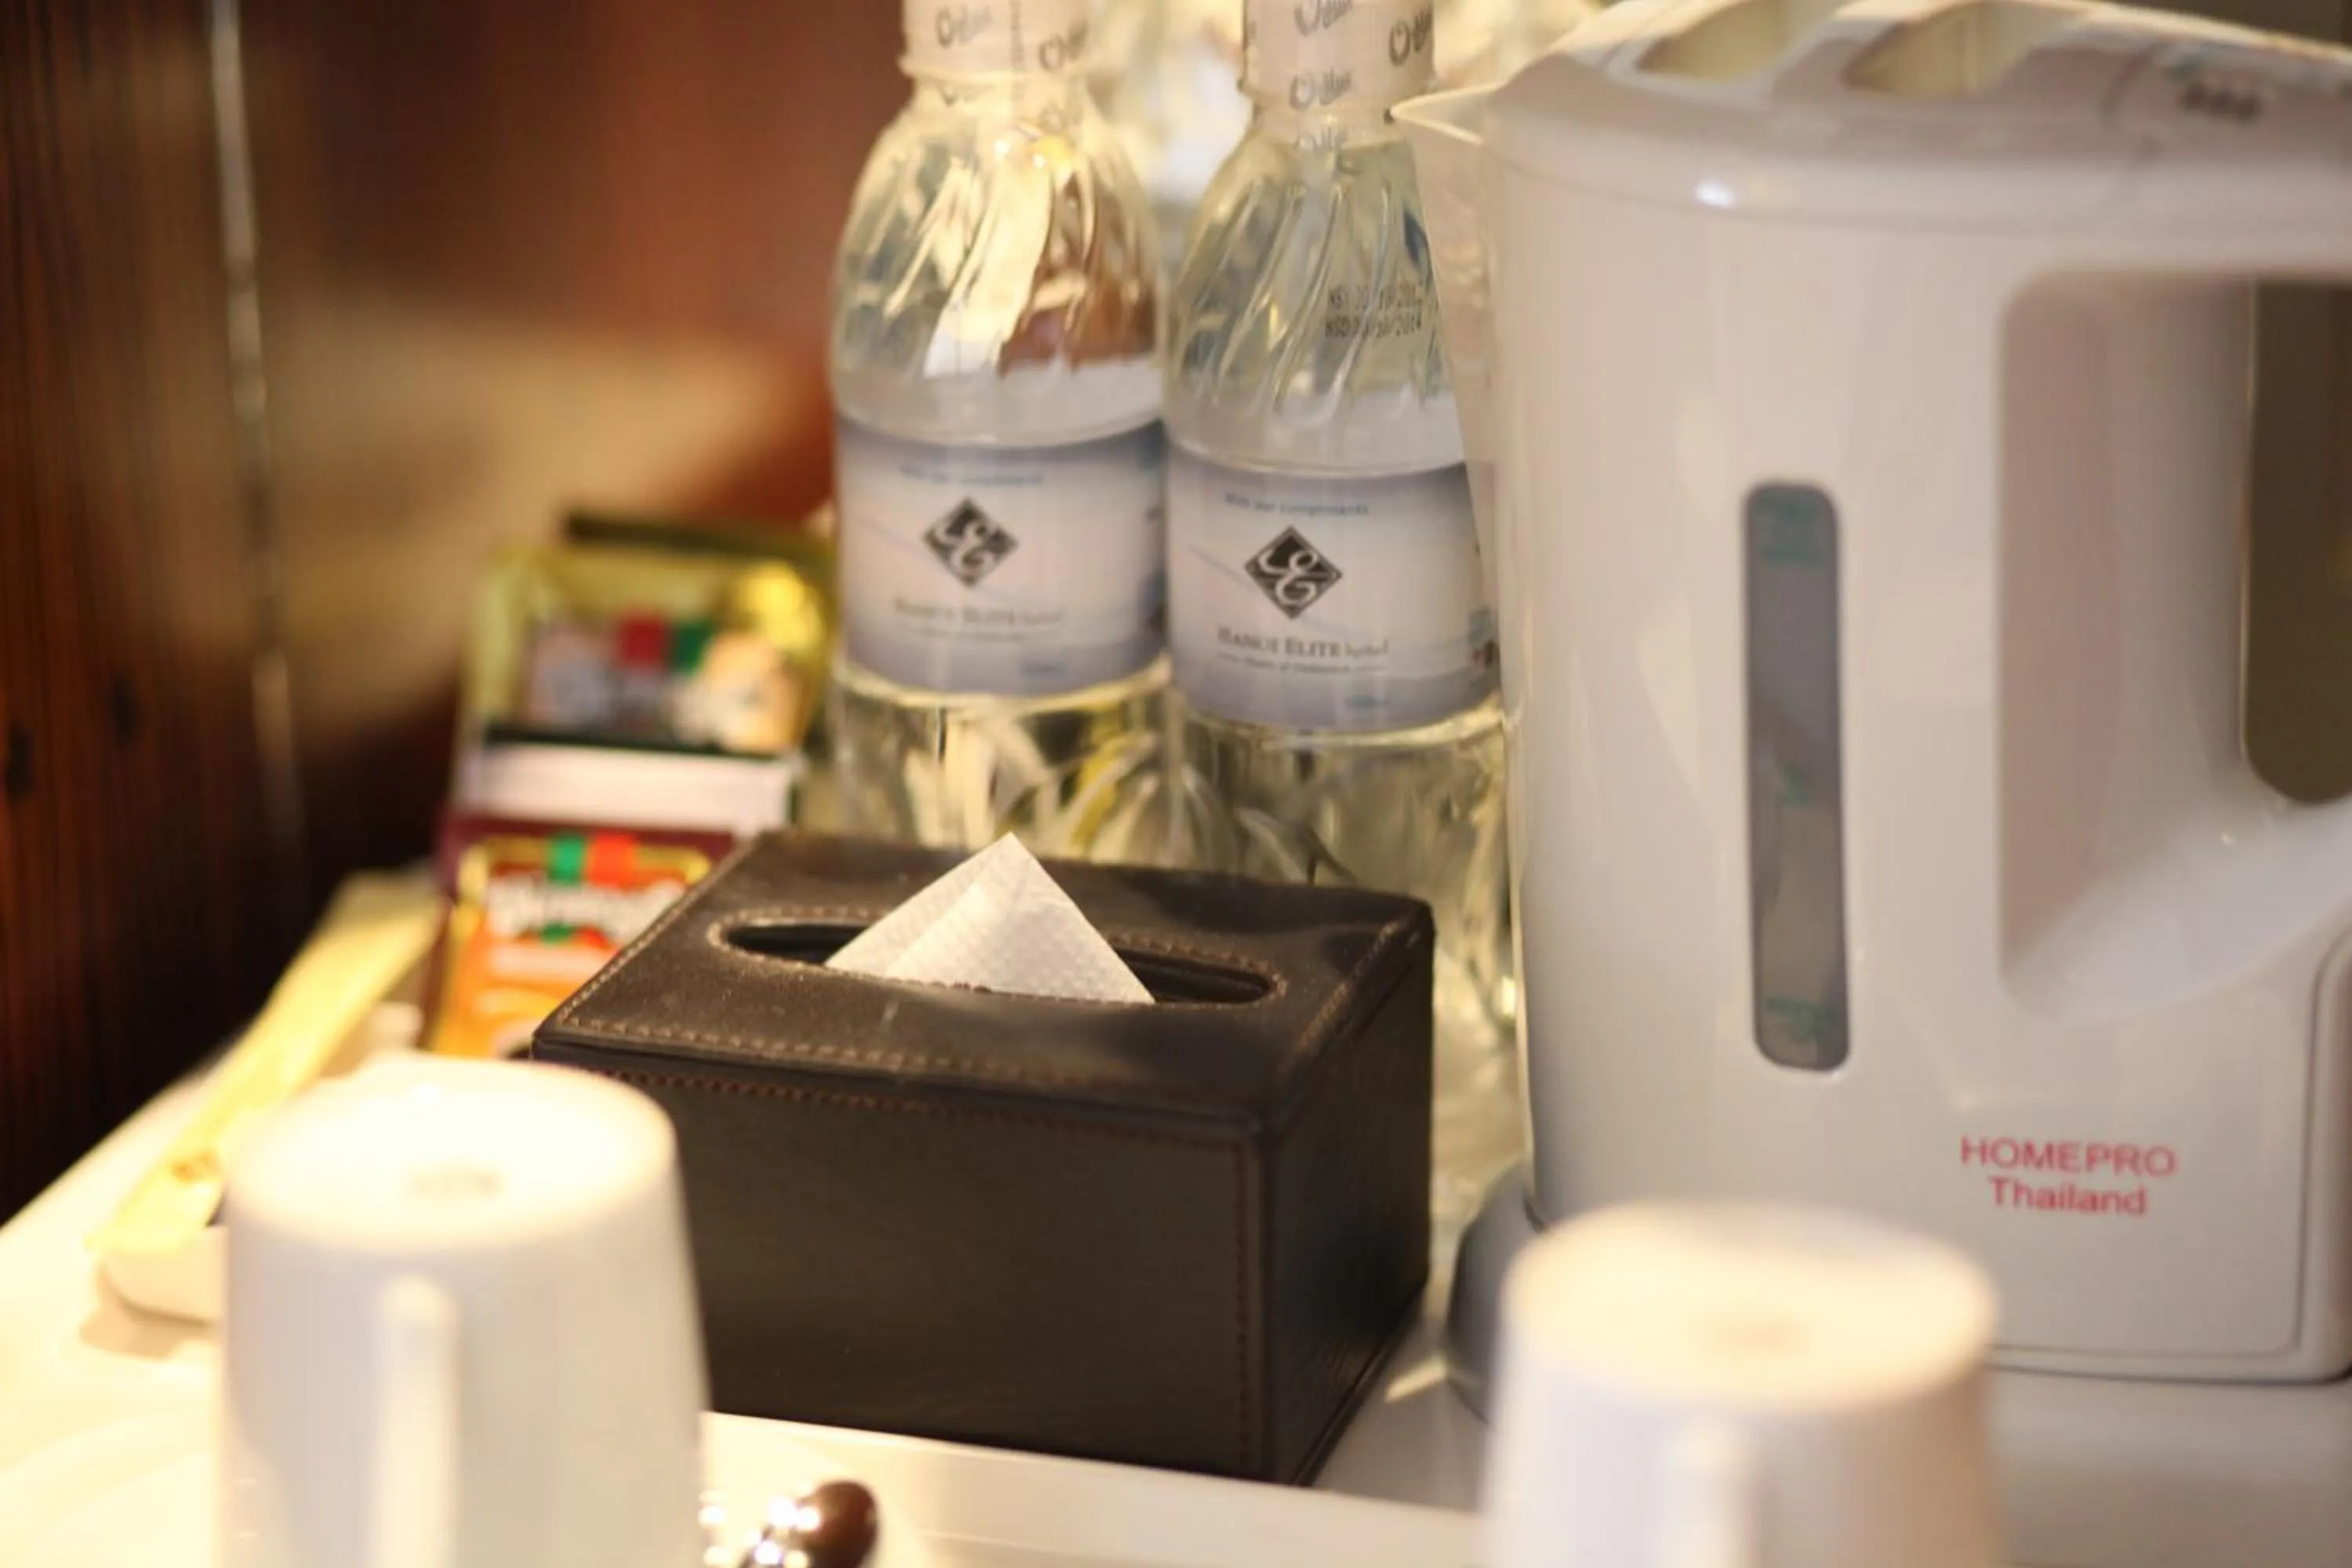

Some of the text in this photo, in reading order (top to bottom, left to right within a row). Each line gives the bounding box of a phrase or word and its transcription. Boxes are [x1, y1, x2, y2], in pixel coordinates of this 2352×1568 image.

[1284, 635, 1341, 659] ELITE
[1961, 1136, 2176, 1178] HOMEPRO
[1990, 1176, 2147, 1218] Thailand
